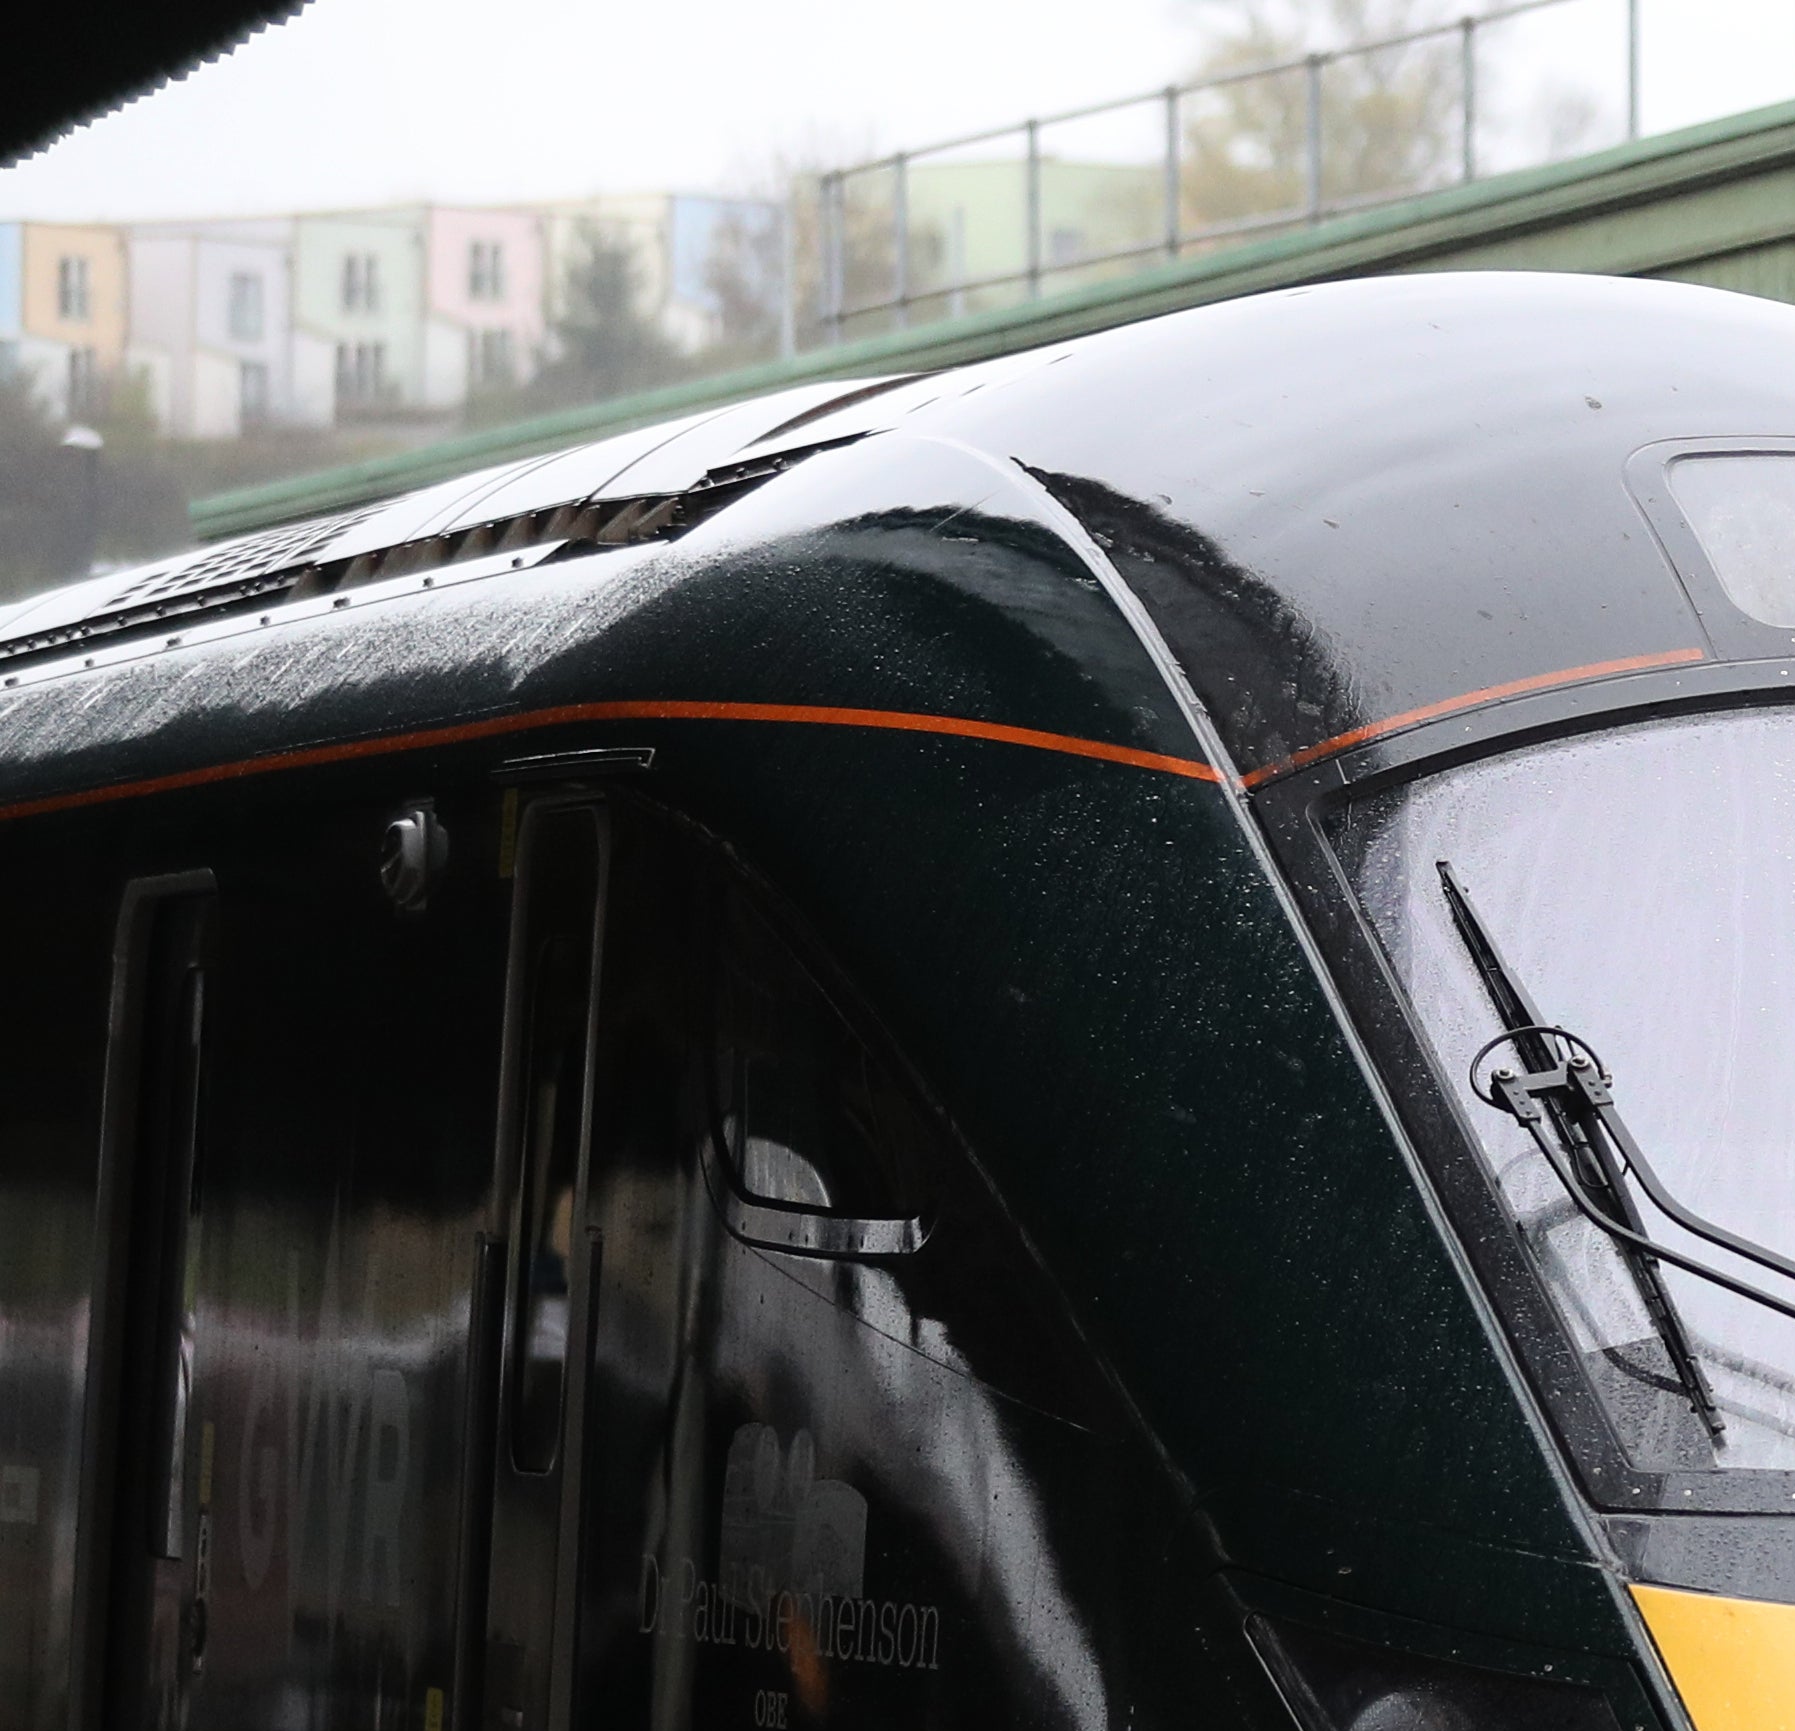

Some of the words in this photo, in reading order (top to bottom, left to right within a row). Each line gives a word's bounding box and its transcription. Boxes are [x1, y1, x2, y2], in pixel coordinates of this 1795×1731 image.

[638, 1552, 671, 1637] Dr
[676, 1554, 738, 1646] Paul
[744, 1564, 939, 1671] Stephenson
[754, 1689, 790, 1730] OBE
